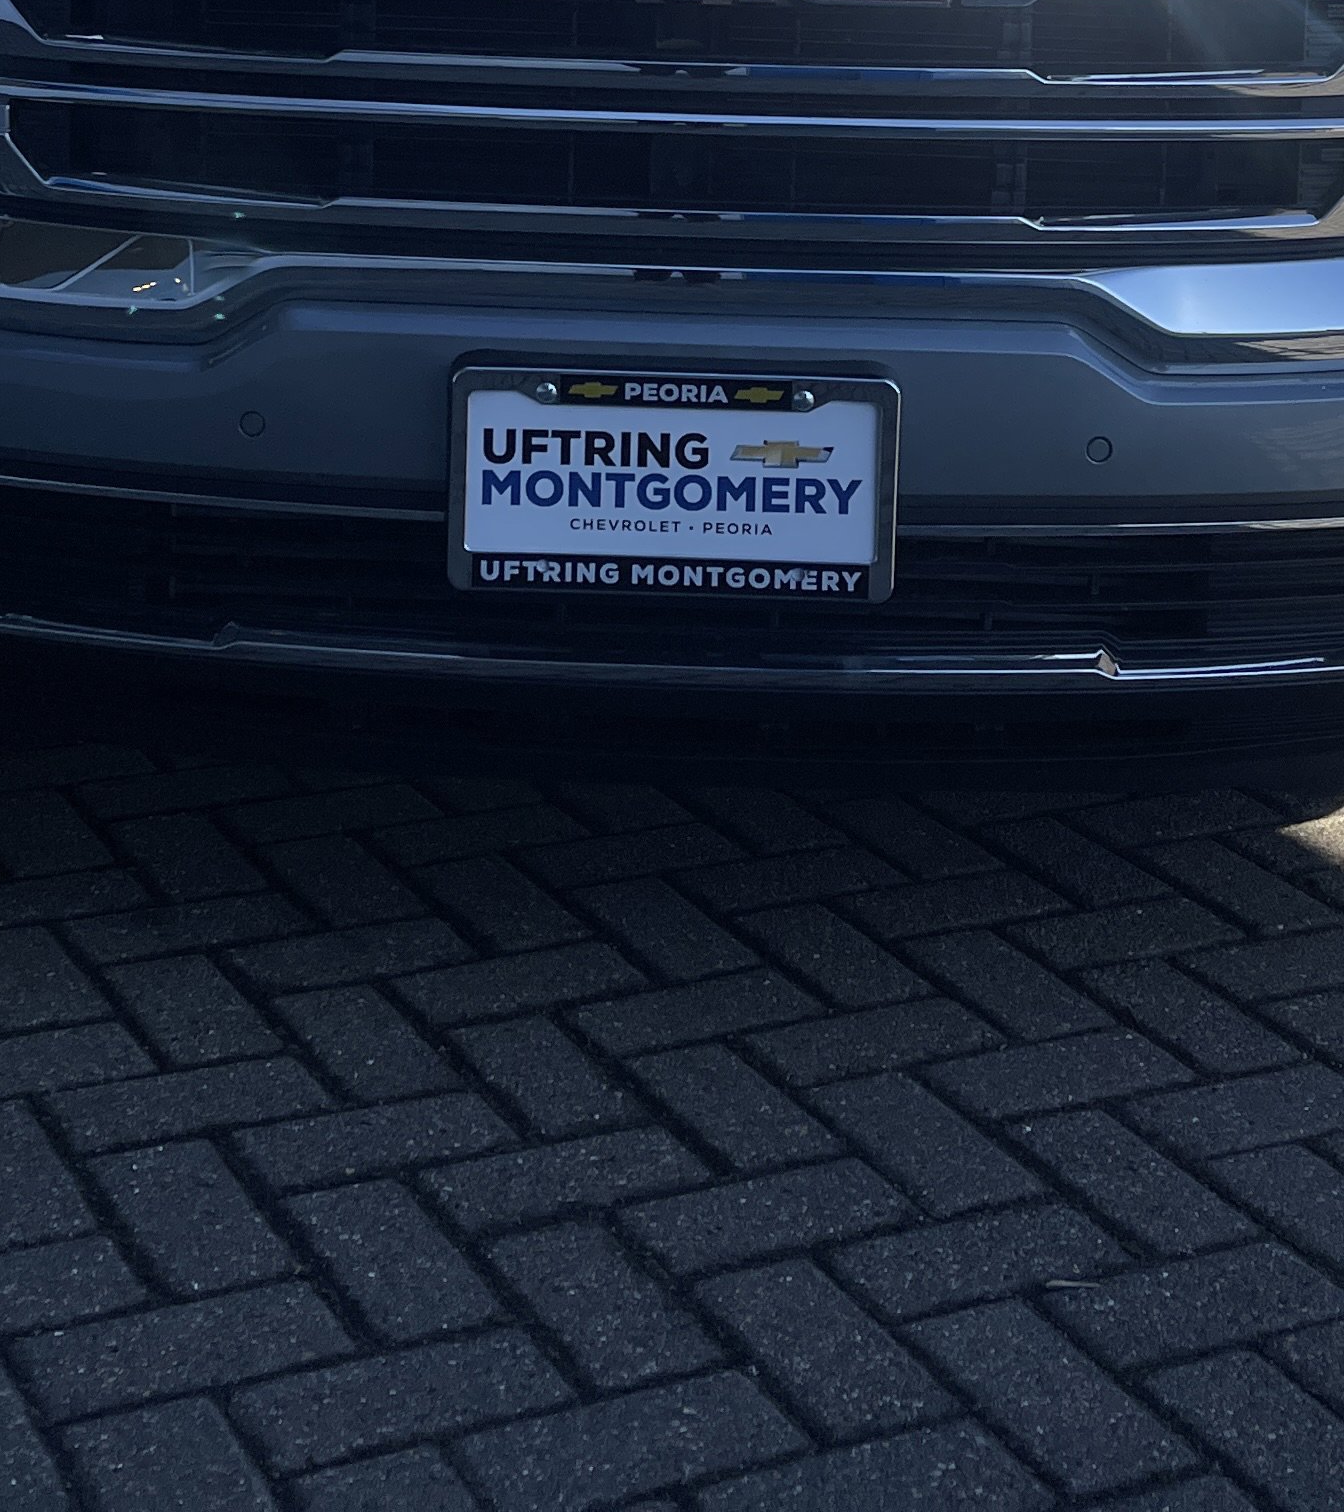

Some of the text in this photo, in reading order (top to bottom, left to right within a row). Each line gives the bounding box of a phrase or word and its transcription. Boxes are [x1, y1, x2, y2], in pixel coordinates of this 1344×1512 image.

[623, 382, 729, 404] PEORIA
[482, 427, 710, 470] UFTRING
[480, 469, 863, 515] MONTGOMERY
[569, 517, 773, 536] CHEVROLET PEORIA
[479, 559, 863, 593] UFTRING MONTGOMERY
